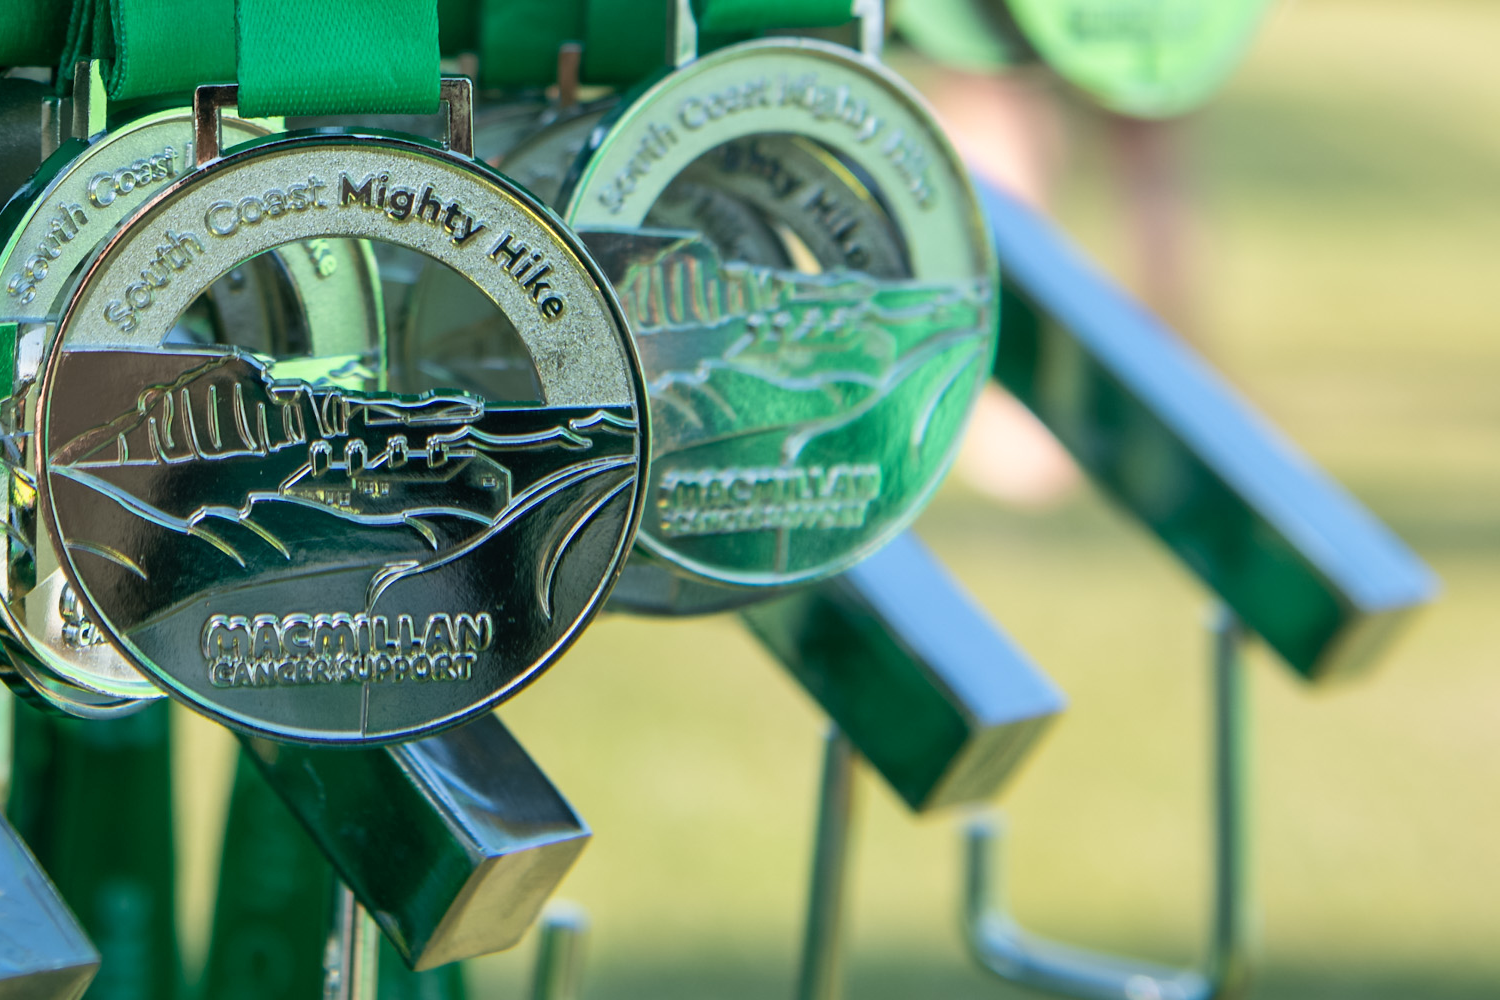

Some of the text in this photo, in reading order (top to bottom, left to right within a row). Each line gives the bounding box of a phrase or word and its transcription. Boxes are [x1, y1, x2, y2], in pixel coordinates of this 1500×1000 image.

[6, 144, 181, 306] South Coast
[102, 170, 568, 333] South Coast Mighty Hike
[201, 611, 493, 660] MACMILLAN
[208, 650, 478, 689] CANCER SUPPORT
